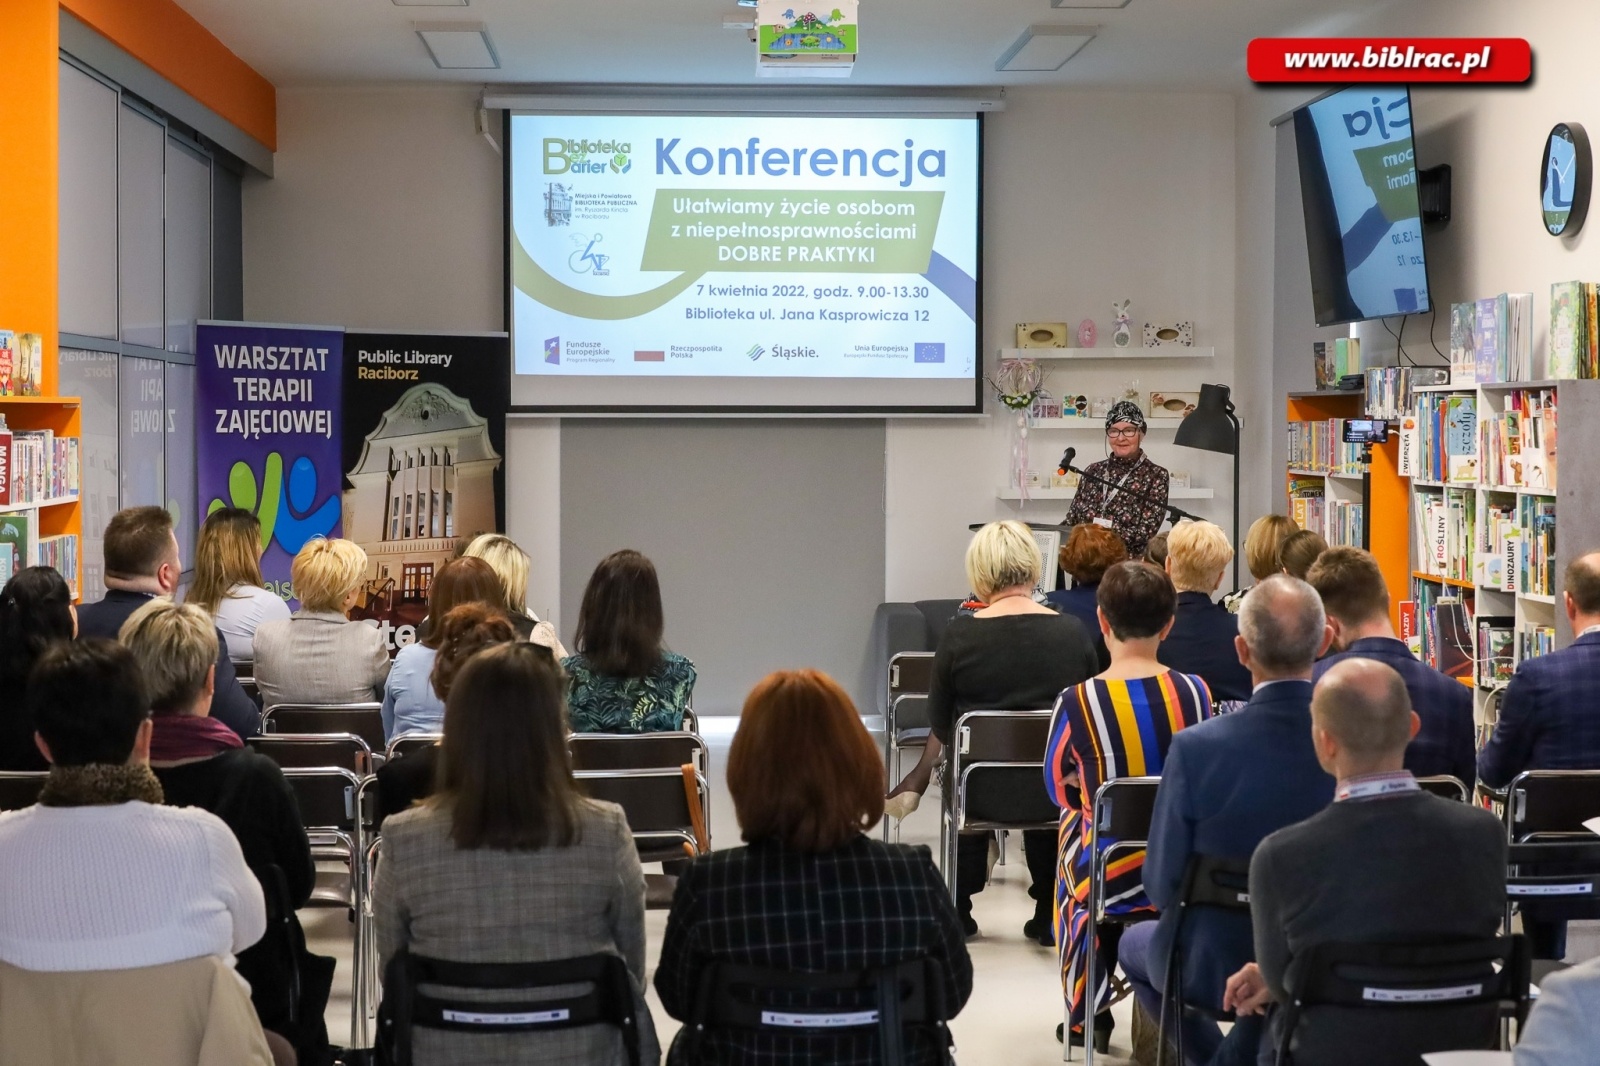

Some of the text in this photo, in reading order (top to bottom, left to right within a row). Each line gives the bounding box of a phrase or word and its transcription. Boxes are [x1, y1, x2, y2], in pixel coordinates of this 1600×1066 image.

[655, 137, 946, 188] Konferencja
[673, 197, 915, 218] Ułatwiamy życie osobom
[671, 221, 917, 242] z niepełnosprawnościami
[718, 245, 875, 263] DOBRE PRAKTYKI
[696, 284, 930, 300] 7 kwietnia 2022, godz. 9.00-13.30
[685, 307, 930, 324] Biblioteka ul. Jana Kasprowicza 12
[214, 344, 329, 372] WARSZTAT
[566, 348, 610, 357] Europejskie
[670, 345, 723, 353] Rzeczpospolita
[670, 352, 693, 360] Polska
[771, 343, 819, 361] Śląskie.
[871, 345, 909, 353] Europejska
[358, 349, 453, 368] Public Library
[358, 366, 419, 380] Raciborz
[233, 377, 313, 402] TERAPII
[215, 409, 333, 439] ZAJĘCIOWEJ
[1435, 515, 1446, 559] ROŚLINY
[1506, 540, 1515, 590] DINOZAURY
